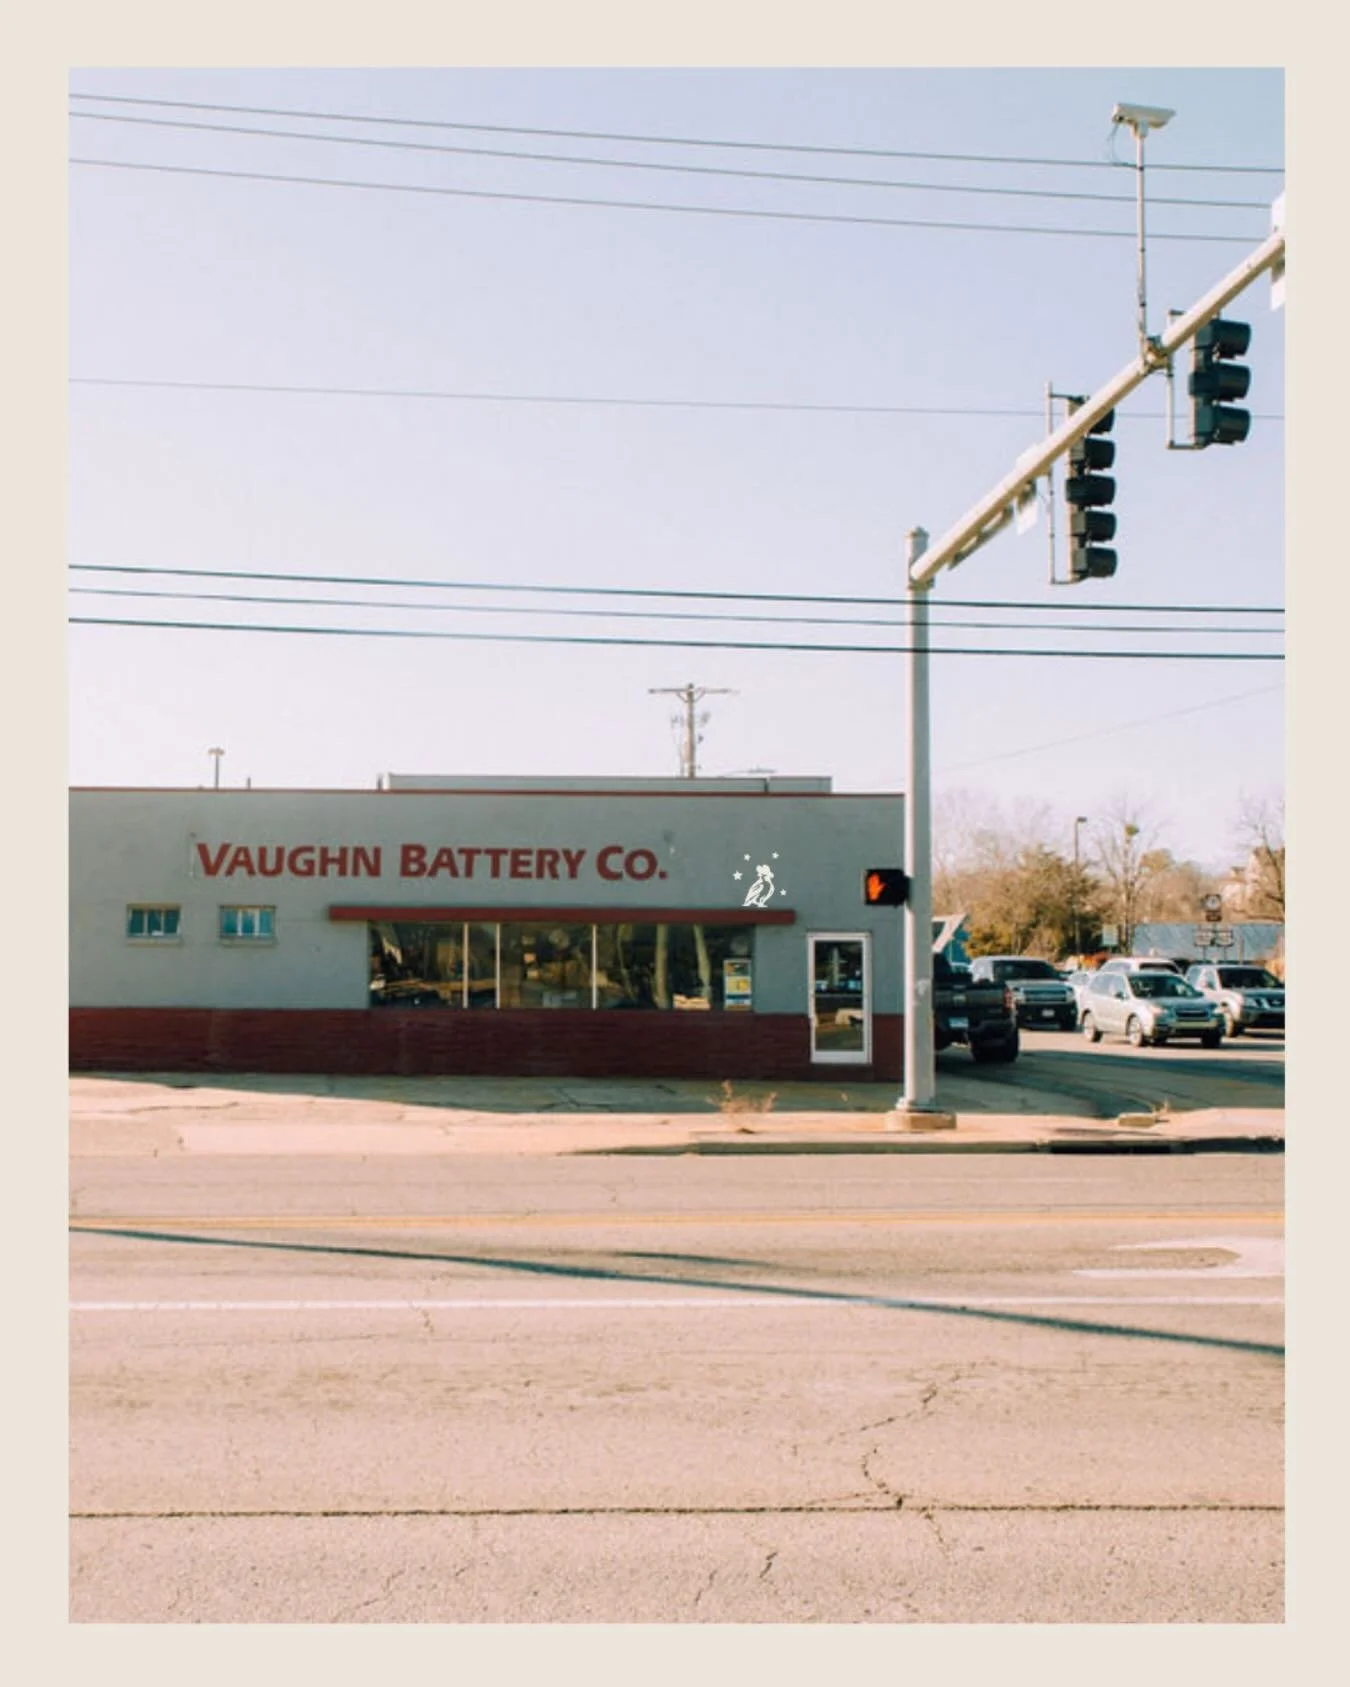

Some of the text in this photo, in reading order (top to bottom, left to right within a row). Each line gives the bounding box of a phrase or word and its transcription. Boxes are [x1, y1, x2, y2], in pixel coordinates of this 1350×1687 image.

[197, 842, 668, 881] VAUGHN BATTERY CO.
